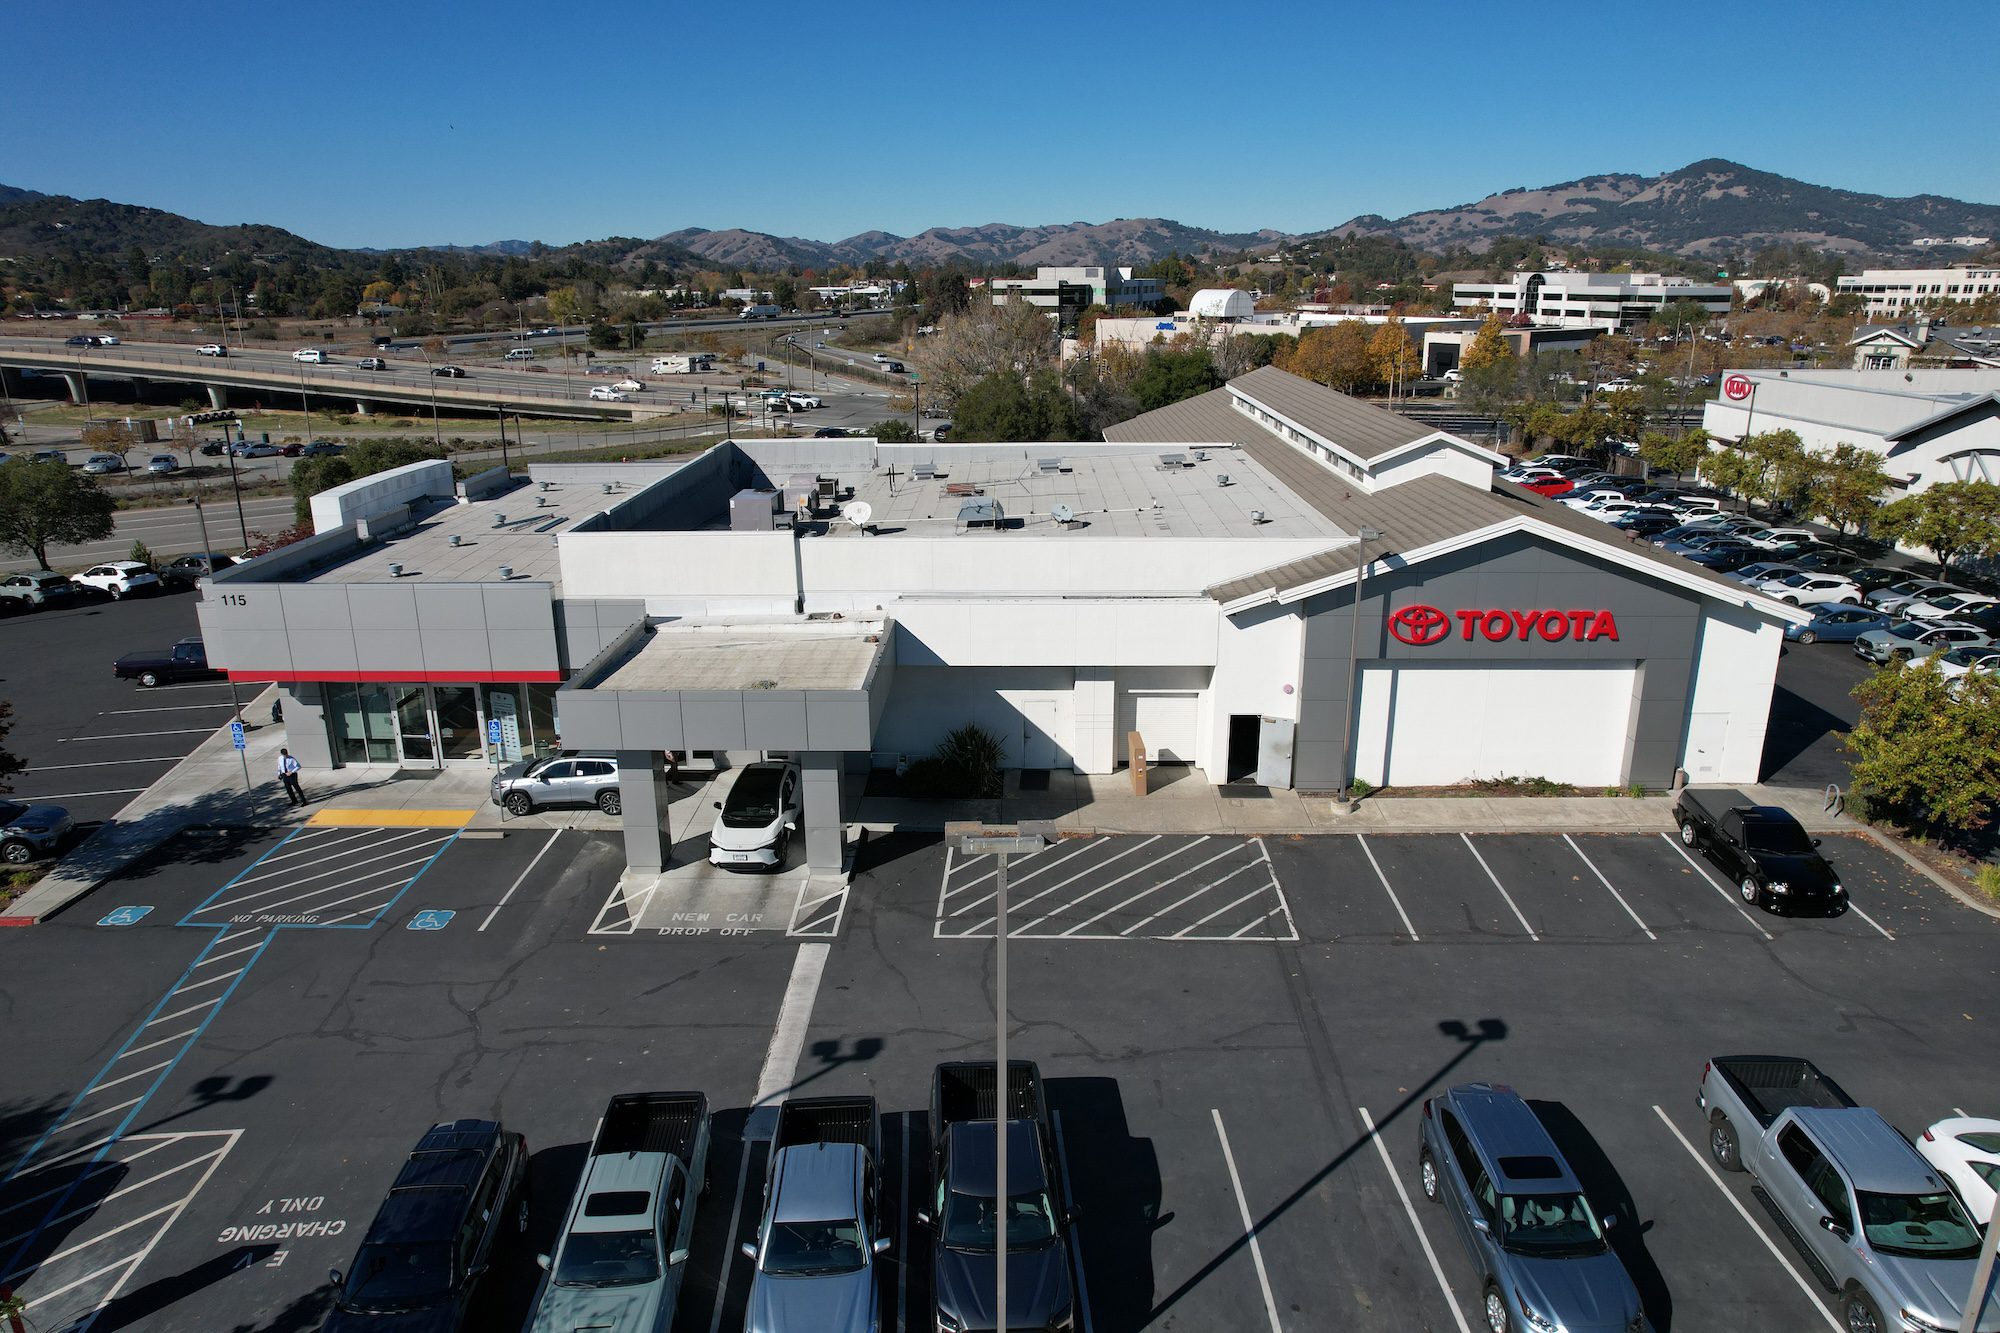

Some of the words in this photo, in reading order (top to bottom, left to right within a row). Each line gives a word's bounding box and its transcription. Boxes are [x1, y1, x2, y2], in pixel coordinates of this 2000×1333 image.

[221, 595, 246, 606] 115
[1456, 610, 1619, 641] TOYOTA
[229, 914, 253, 922] NO
[255, 914, 320, 923] PARKING
[671, 912, 710, 922] NEW
[726, 913, 763, 922] CAR
[658, 927, 710, 936] DROP
[719, 928, 757, 936] OFF
[256, 1196, 325, 1214] ONLY
[218, 1220, 347, 1242] CHARGING
